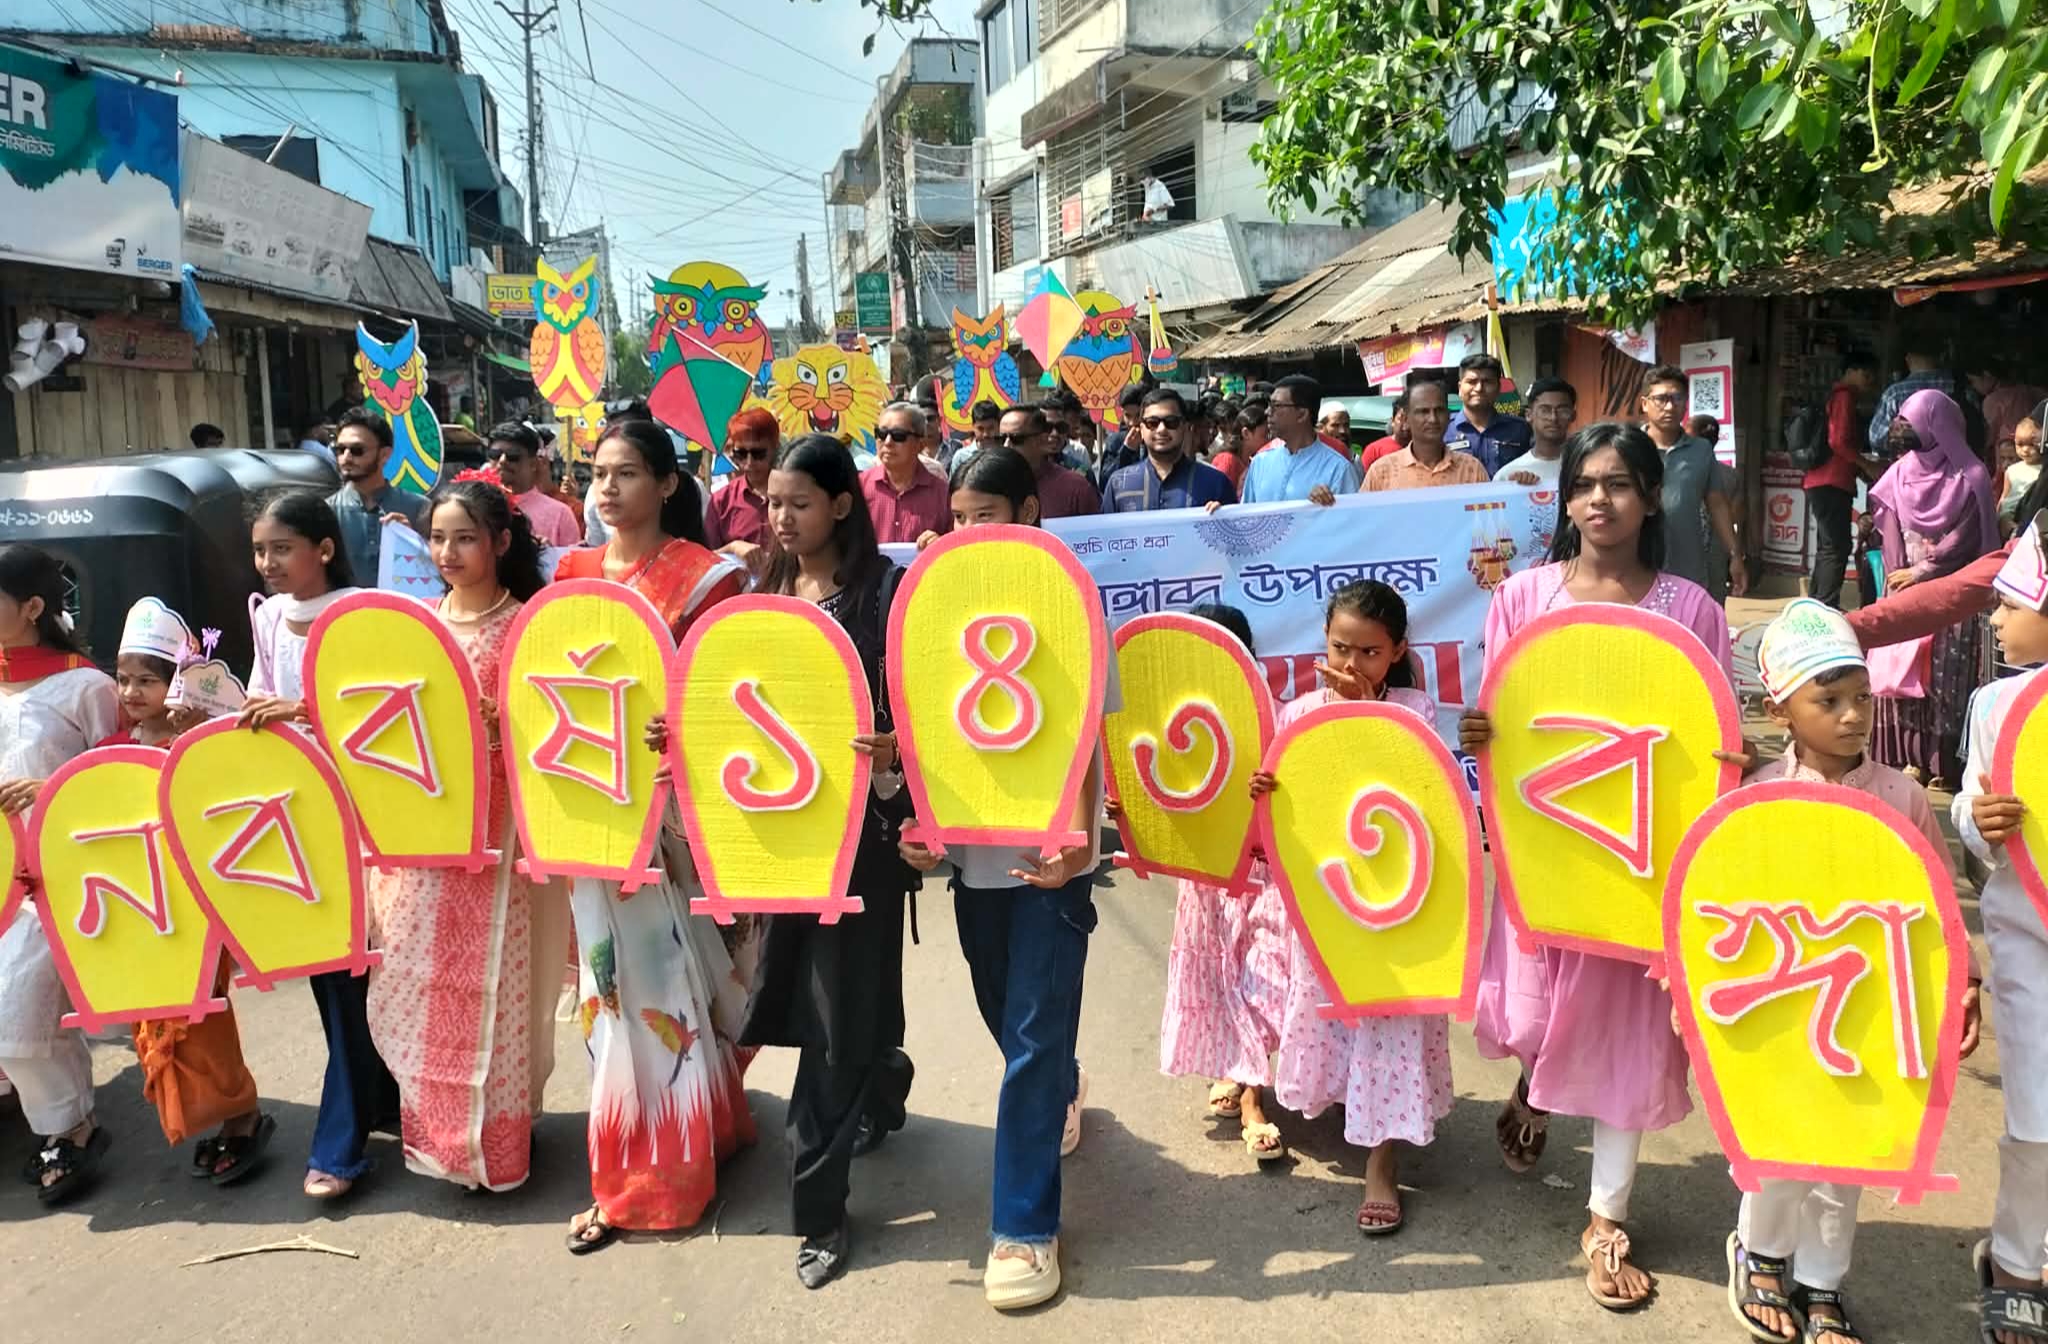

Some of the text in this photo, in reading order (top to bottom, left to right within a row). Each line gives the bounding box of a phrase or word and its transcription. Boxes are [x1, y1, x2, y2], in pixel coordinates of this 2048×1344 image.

[1239, 556, 1438, 603] উপলক্ষে
[337, 678, 443, 799] ব
[953, 613, 1043, 753] ৪
[721, 678, 823, 813] ১
[1130, 700, 1236, 814] ৩
[1516, 714, 1669, 879] ব
[70, 819, 175, 940] ন
[203, 788, 320, 904] ব
[1314, 782, 1437, 932] ৩
[2005, 1297, 2045, 1328] CAT
